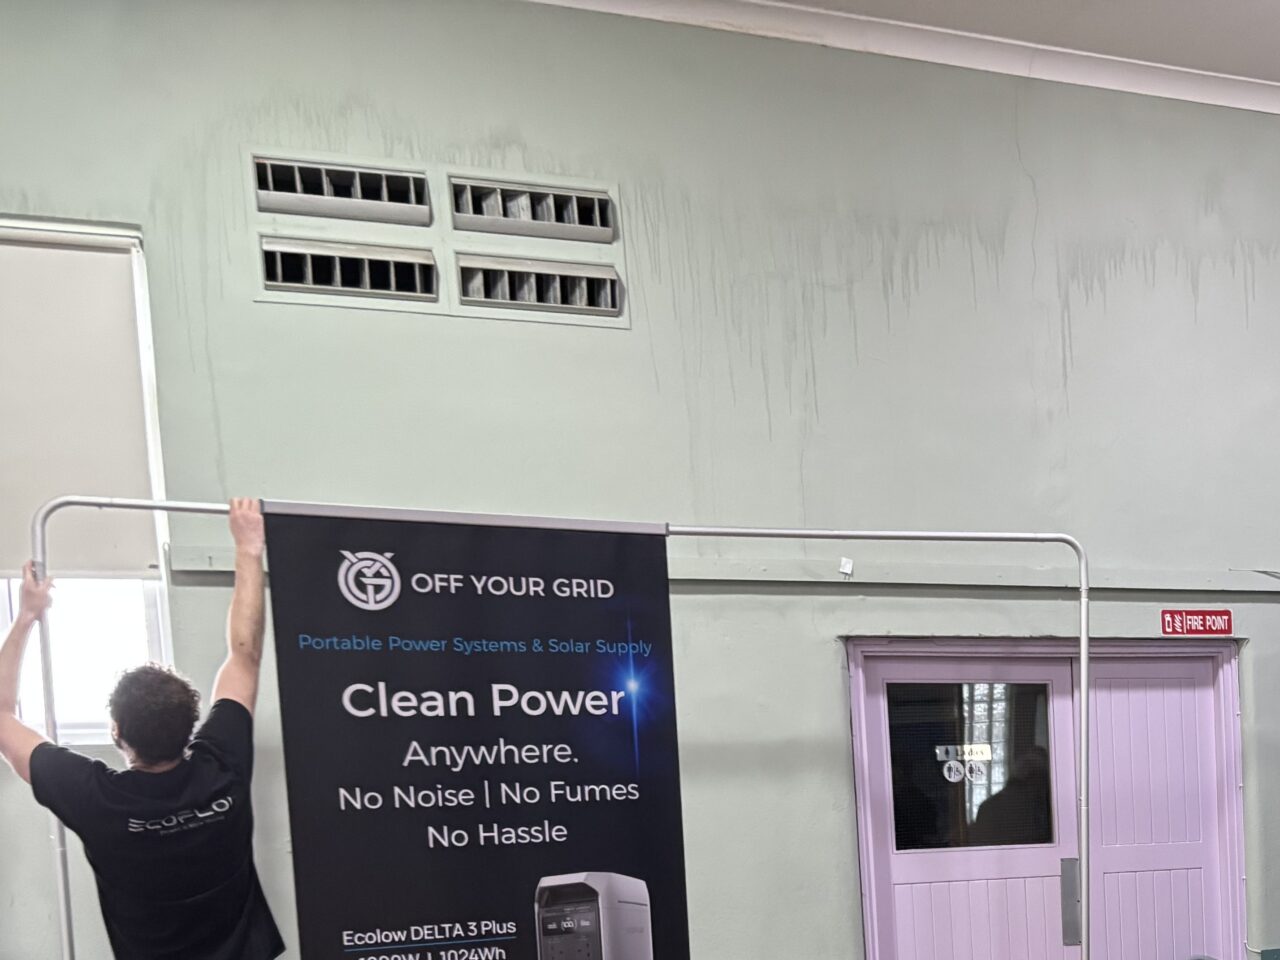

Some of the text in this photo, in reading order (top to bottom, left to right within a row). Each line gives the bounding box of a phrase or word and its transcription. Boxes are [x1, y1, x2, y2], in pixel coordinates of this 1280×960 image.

[411, 573, 615, 598] OFF YOUR GRID
[1186, 616, 1229, 631] FIRE POINT
[299, 634, 652, 657] Portable Power Systems & Solar Supply
[342, 681, 626, 718] Clean Power
[402, 738, 579, 772] Anywhere.
[339, 787, 383, 811] No
[393, 785, 475, 808] Noise
[501, 781, 541, 804] No
[550, 779, 640, 802] Fumes
[128, 796, 233, 832] ECOFLO
[428, 820, 568, 849] No Hassle
[342, 920, 517, 946] Ecolow DELTA 3 Plus
